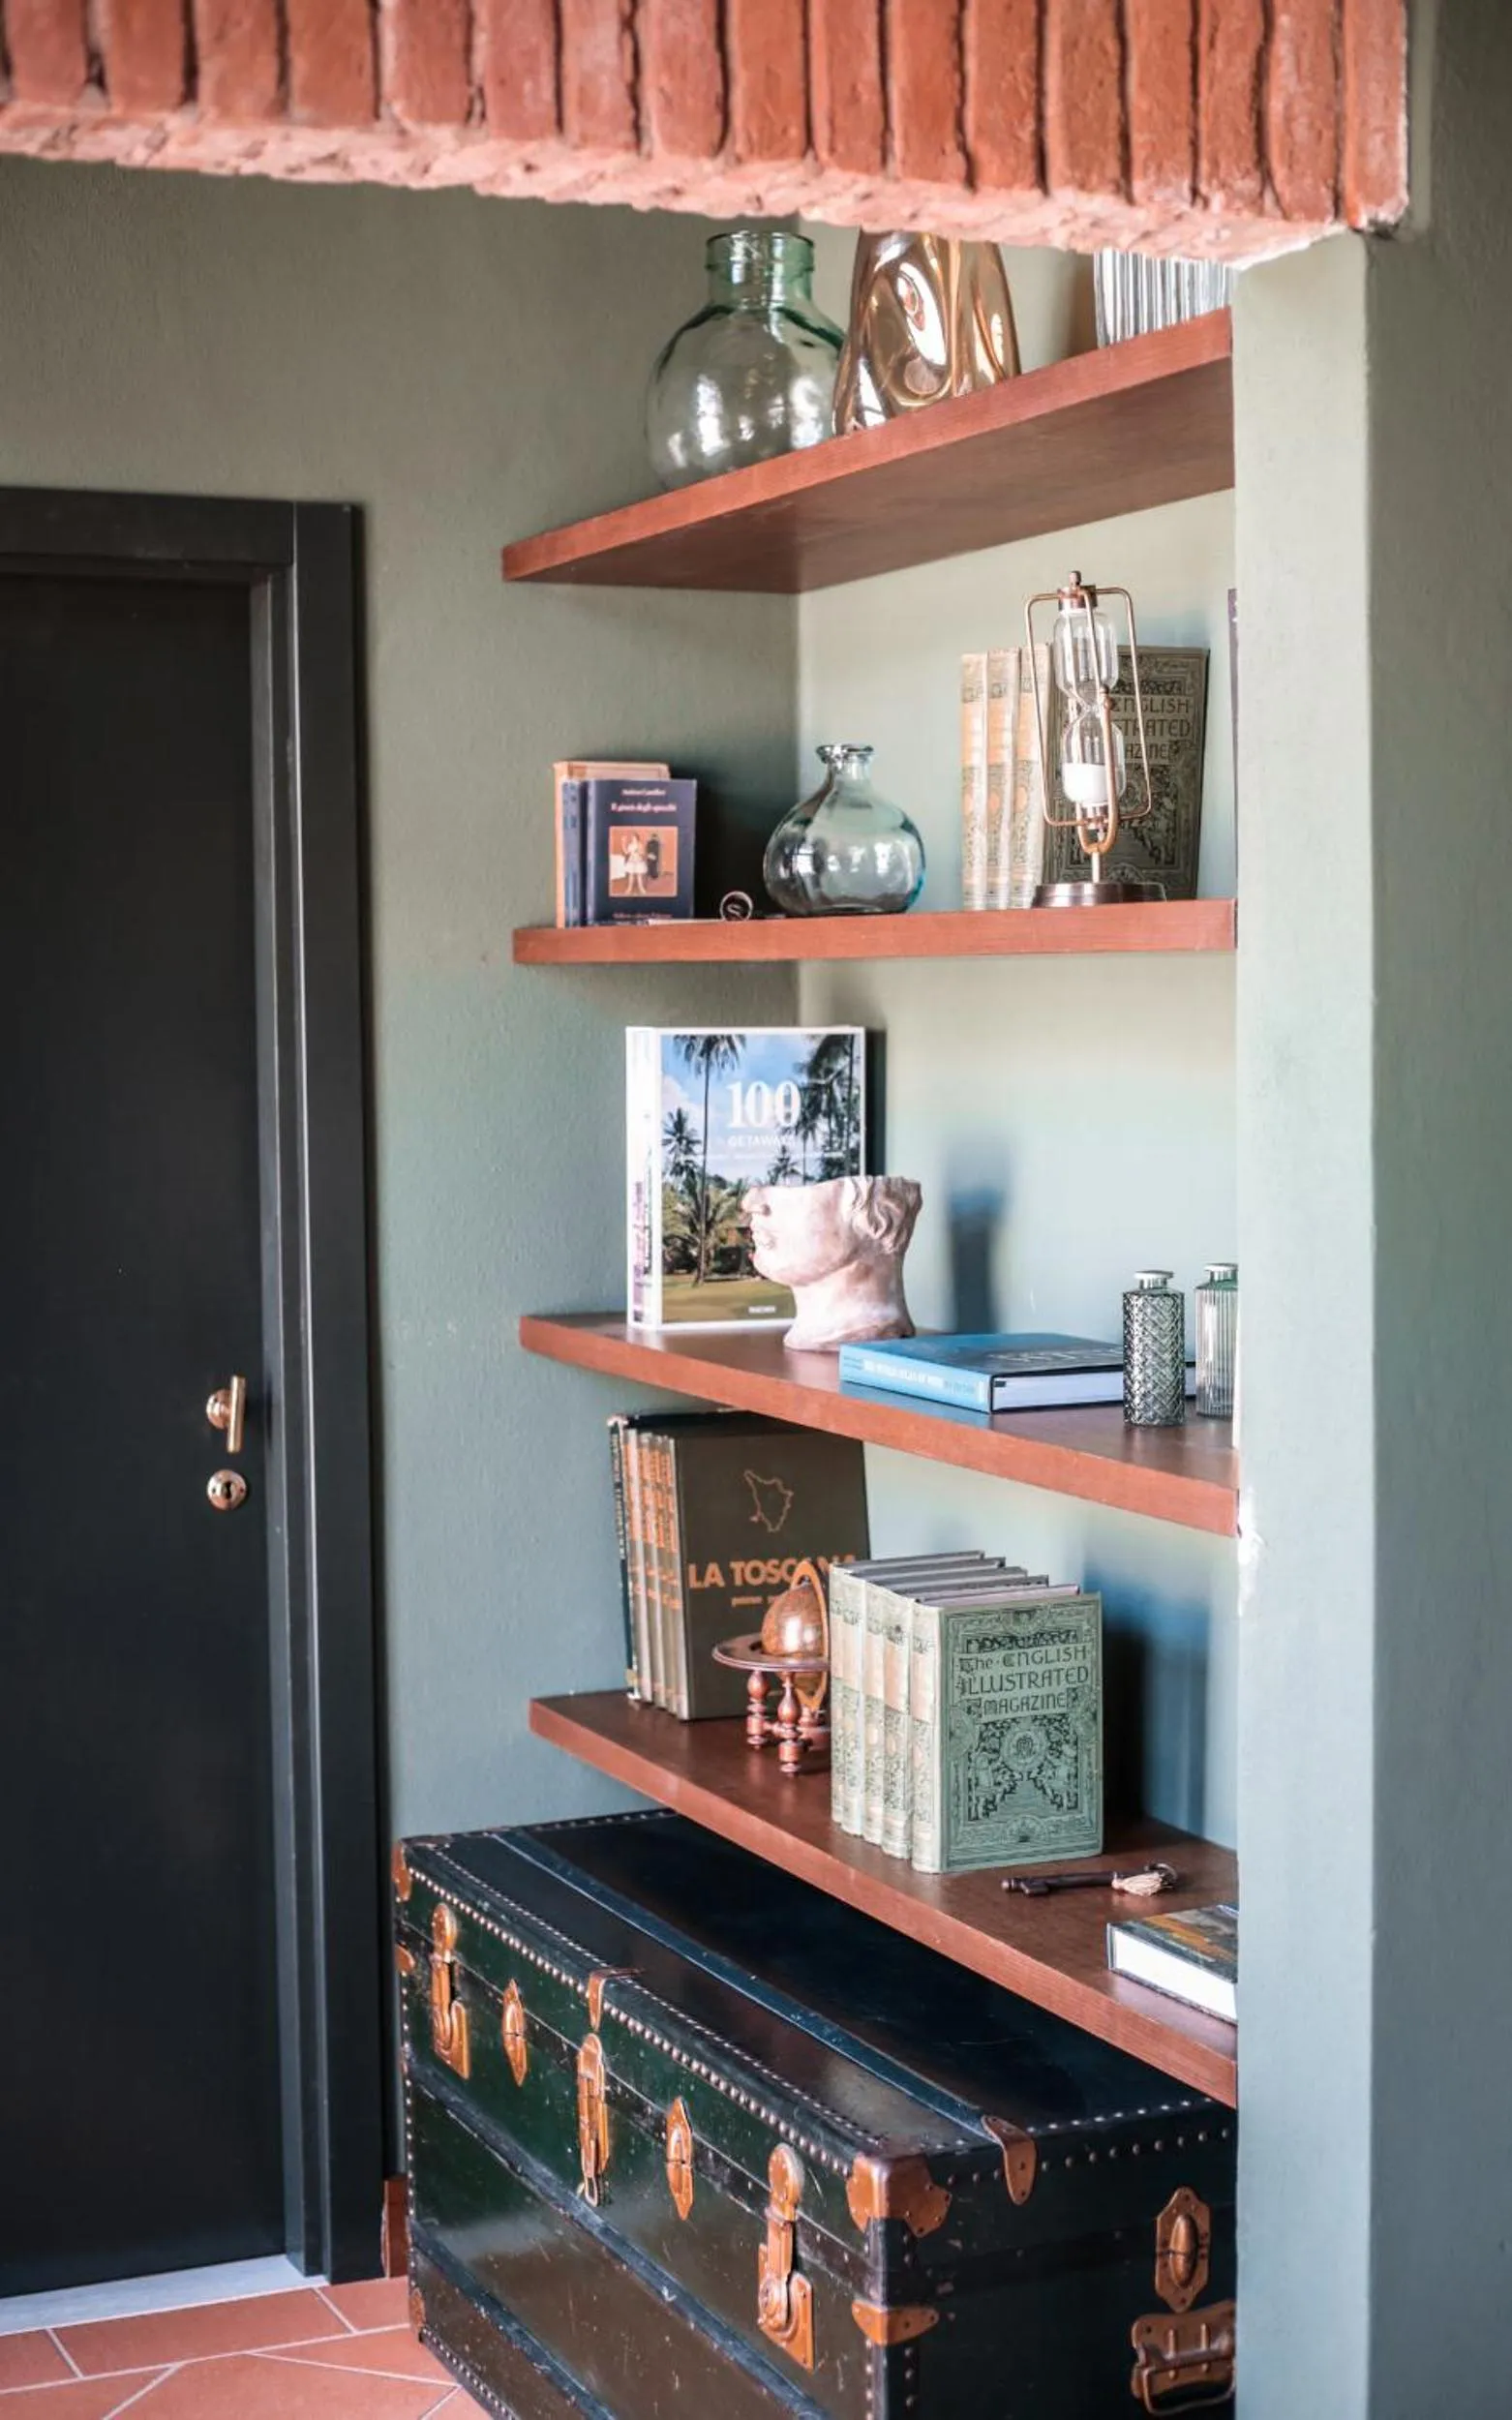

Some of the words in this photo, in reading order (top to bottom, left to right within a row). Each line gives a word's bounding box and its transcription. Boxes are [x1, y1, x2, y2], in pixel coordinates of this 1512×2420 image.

[727, 1079, 802, 1129] 100
[688, 1561, 725, 1588] LA
[1003, 1646, 1087, 1668] ENGLISH
[961, 1665, 1089, 1695] ILLUSTRATED
[983, 1691, 1066, 1716] MAGAZINE
